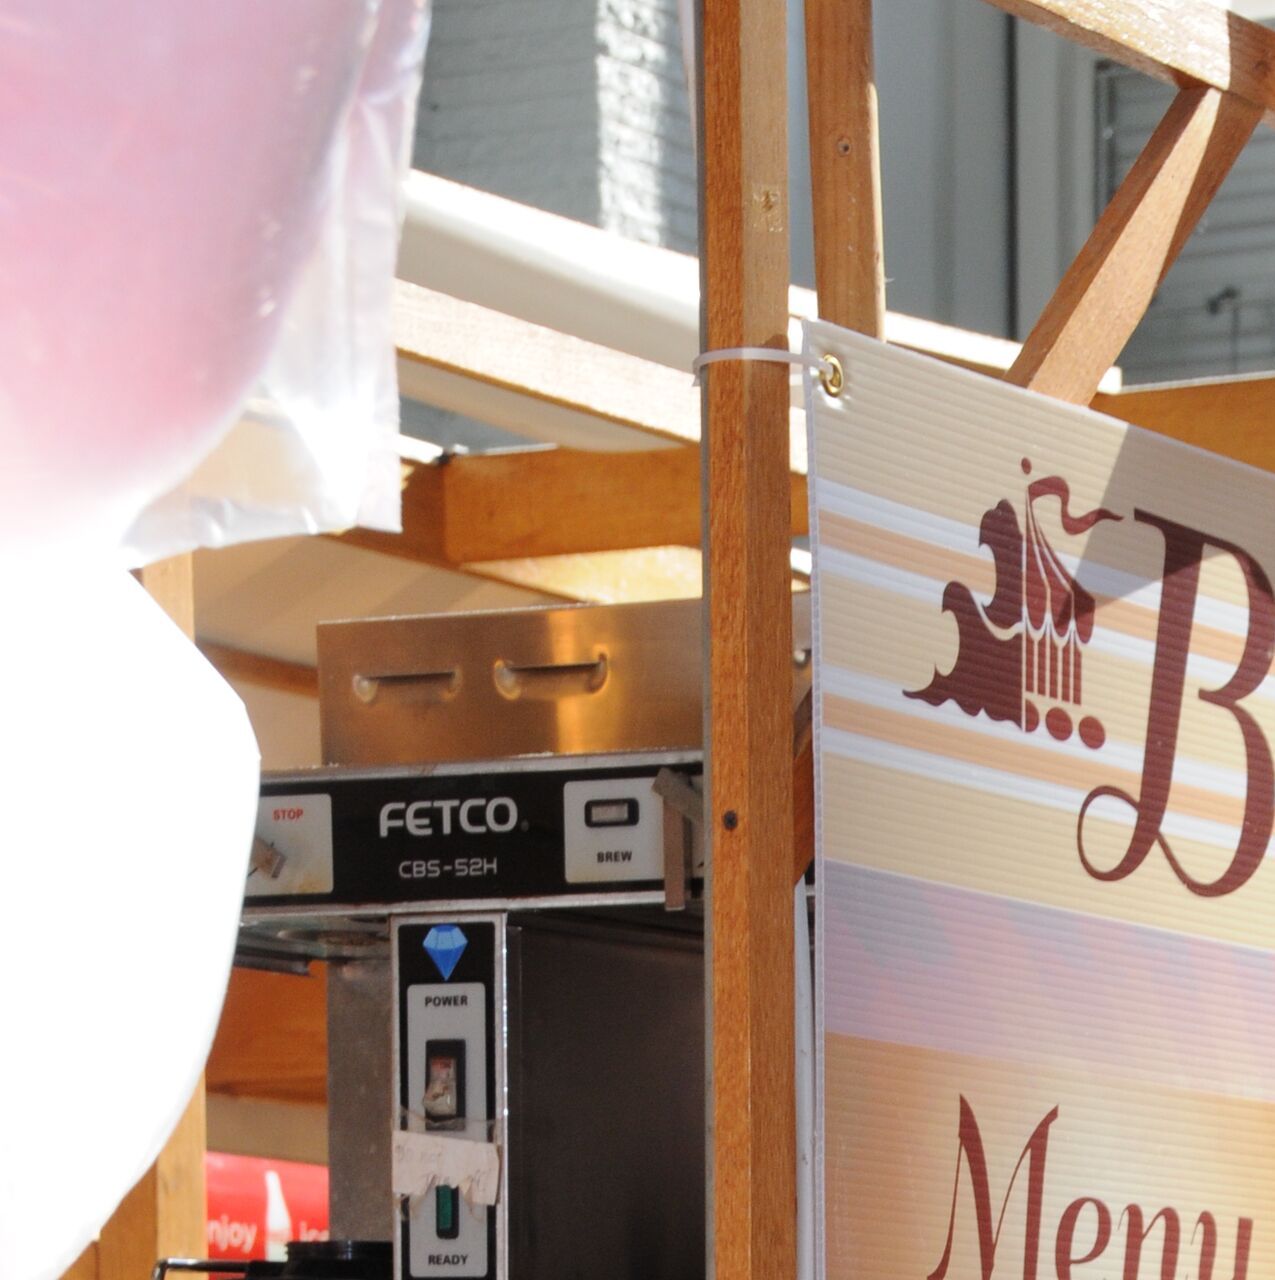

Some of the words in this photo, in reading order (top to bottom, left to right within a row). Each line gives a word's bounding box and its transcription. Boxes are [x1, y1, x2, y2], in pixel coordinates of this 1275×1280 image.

[273, 809, 304, 822] STOP
[379, 796, 519, 838] FETCO
[596, 851, 633, 864] BREW
[398, 858, 498, 879] CBS-52H
[424, 994, 469, 1008] POWER
[208, 1215, 258, 1254] njoy
[428, 1254, 469, 1267] READY
